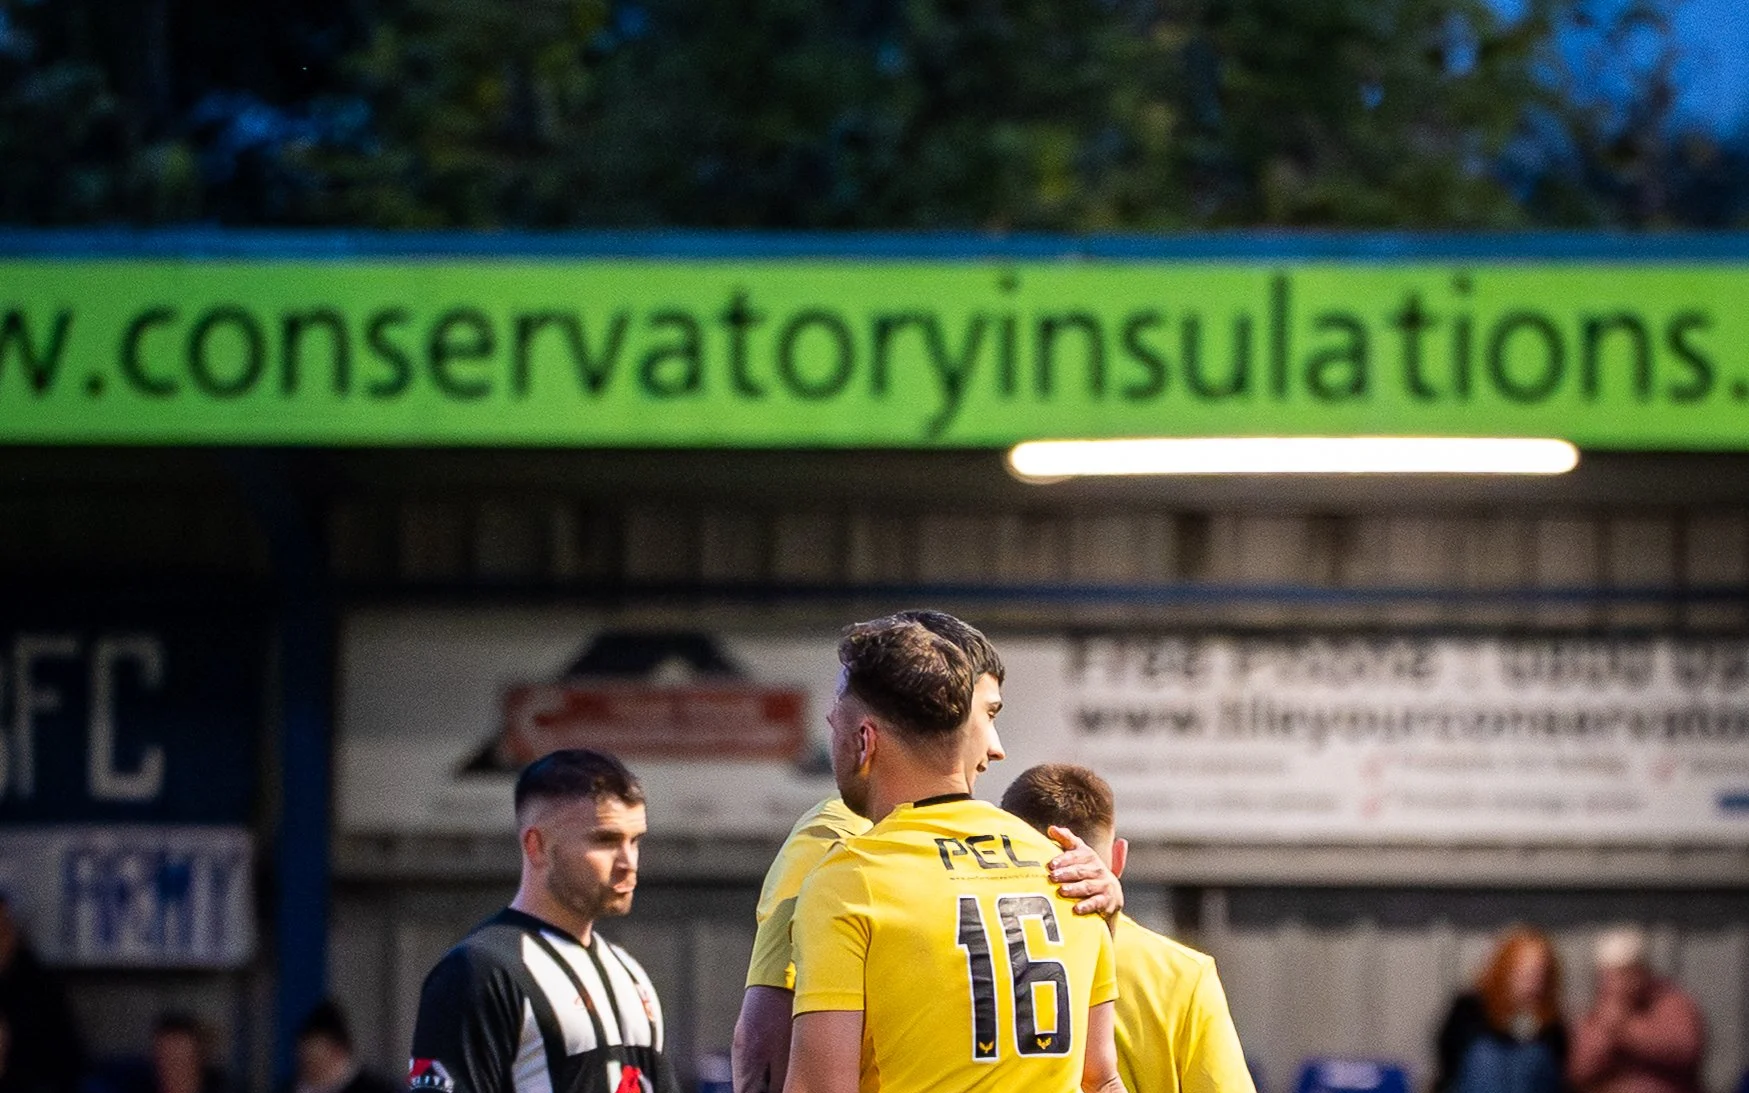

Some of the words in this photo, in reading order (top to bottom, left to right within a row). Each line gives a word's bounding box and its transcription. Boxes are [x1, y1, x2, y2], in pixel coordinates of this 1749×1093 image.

[0, 630, 166, 801] FC
[934, 835, 1041, 871] PEL
[955, 892, 1073, 1064] 16
